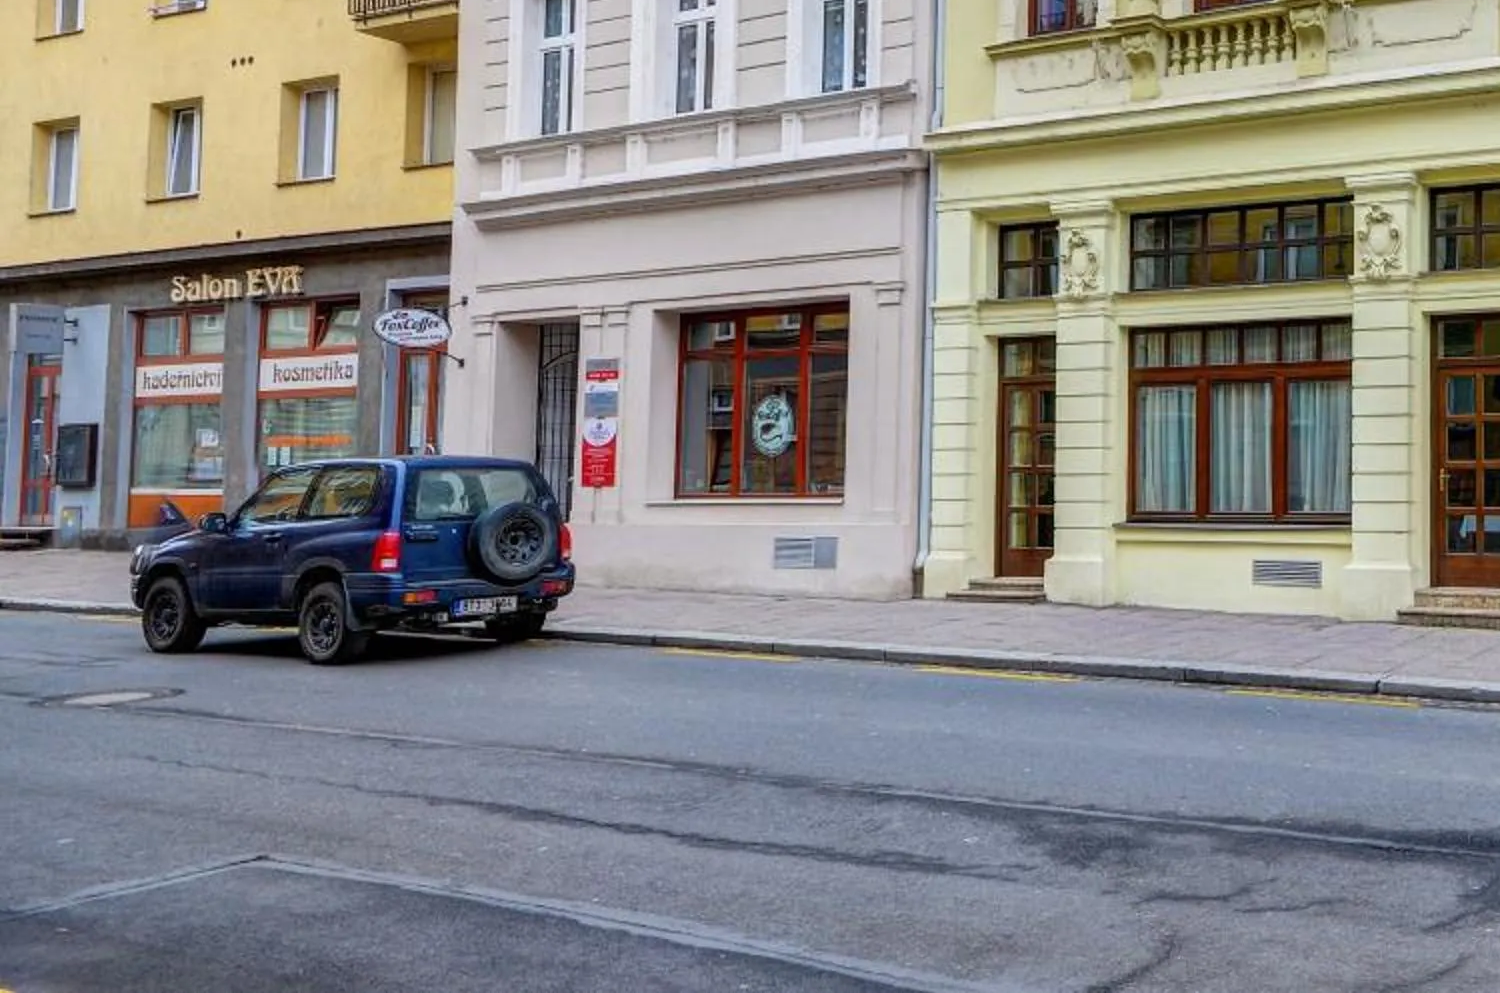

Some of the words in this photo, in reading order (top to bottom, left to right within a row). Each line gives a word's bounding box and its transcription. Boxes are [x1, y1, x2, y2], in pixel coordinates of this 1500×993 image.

[170, 273, 240, 302] Salon
[246, 265, 304, 296] EVA
[273, 361, 353, 383] kosmetika
